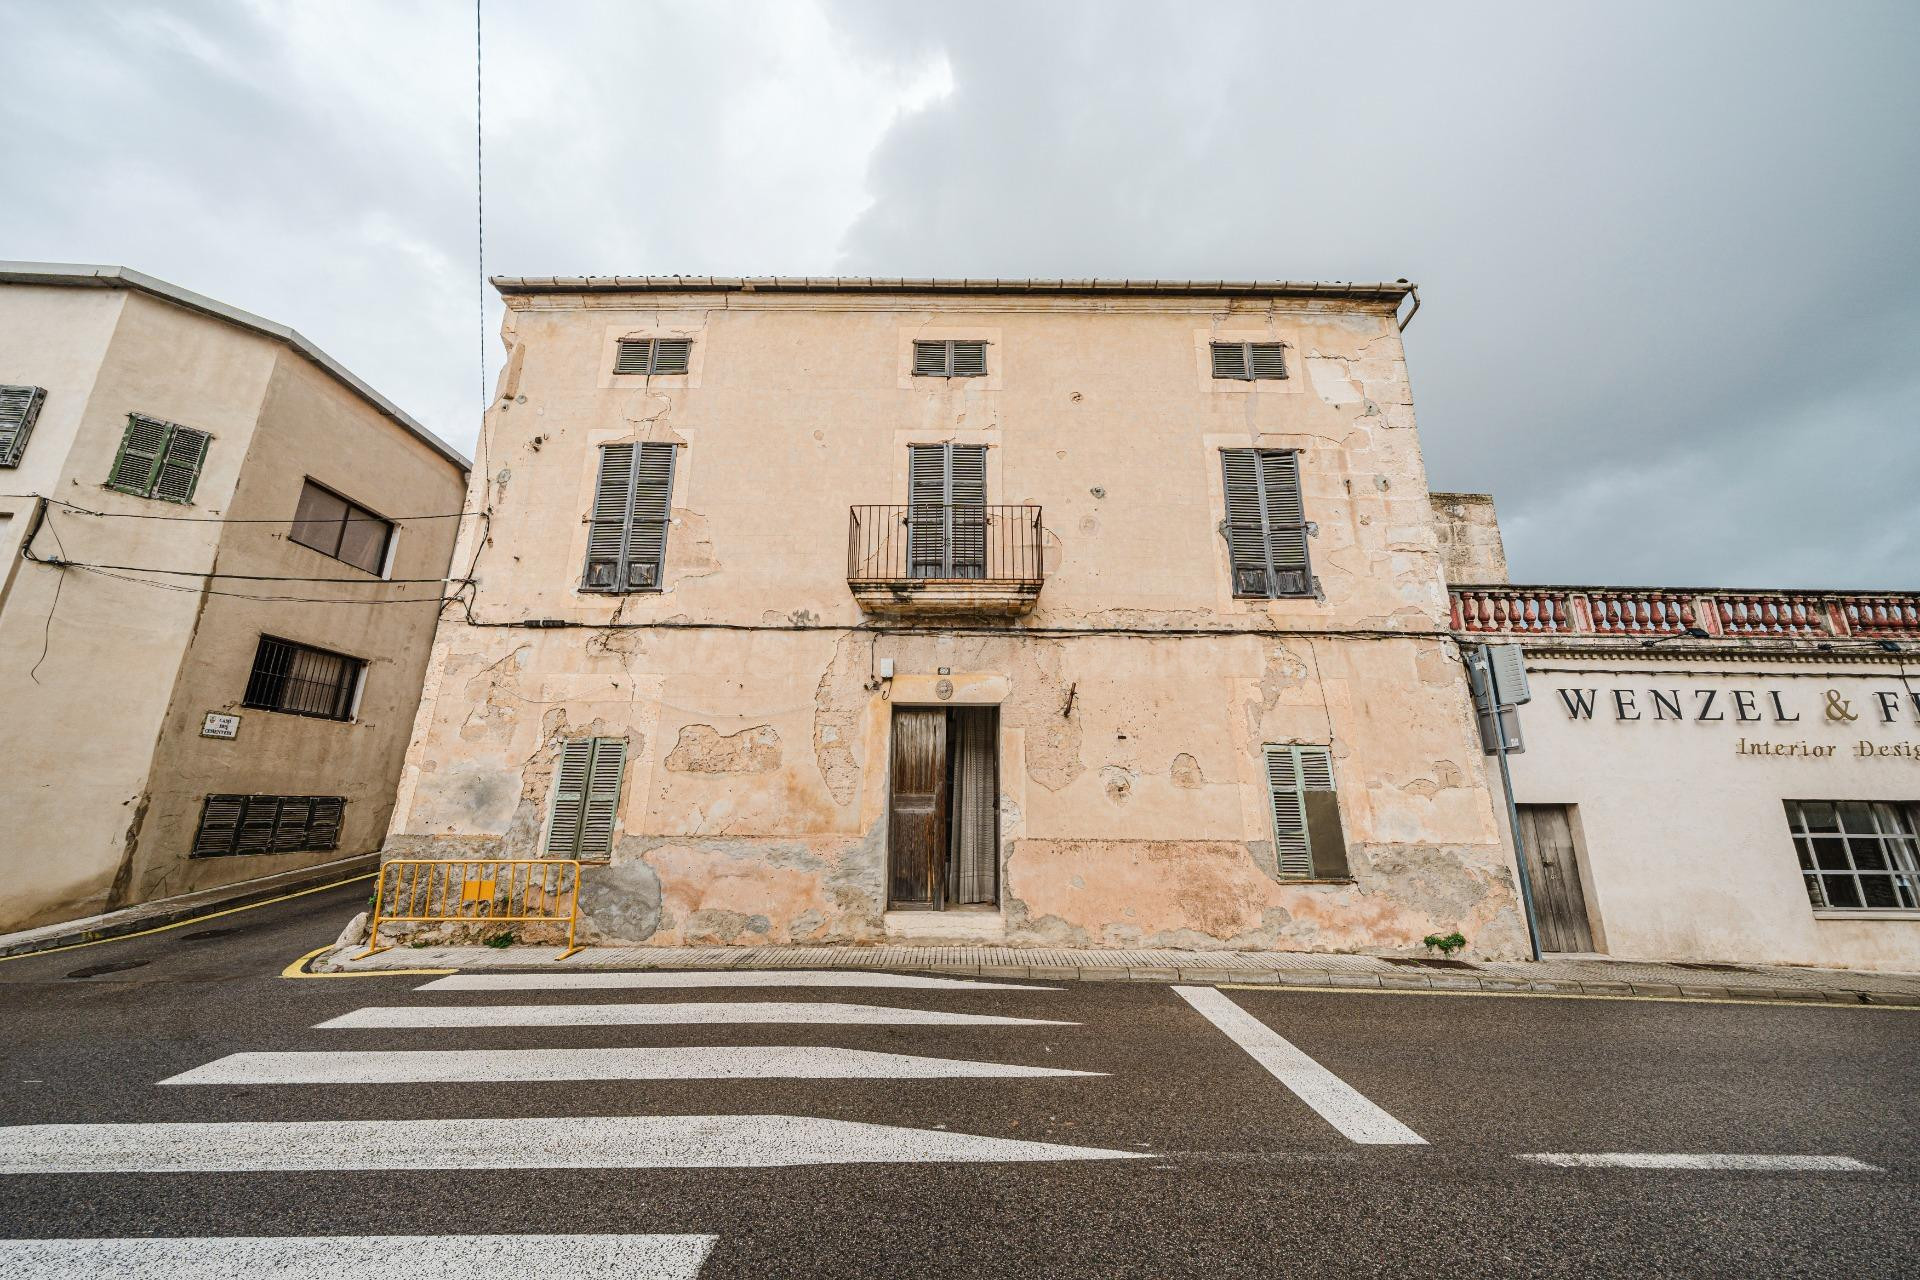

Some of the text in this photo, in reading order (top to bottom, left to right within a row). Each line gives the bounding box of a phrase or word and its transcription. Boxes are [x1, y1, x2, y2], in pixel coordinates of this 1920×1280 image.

[1556, 688, 1799, 721] WENZEL
[1824, 689, 1859, 722] &
[1738, 737, 1837, 757] Interior
